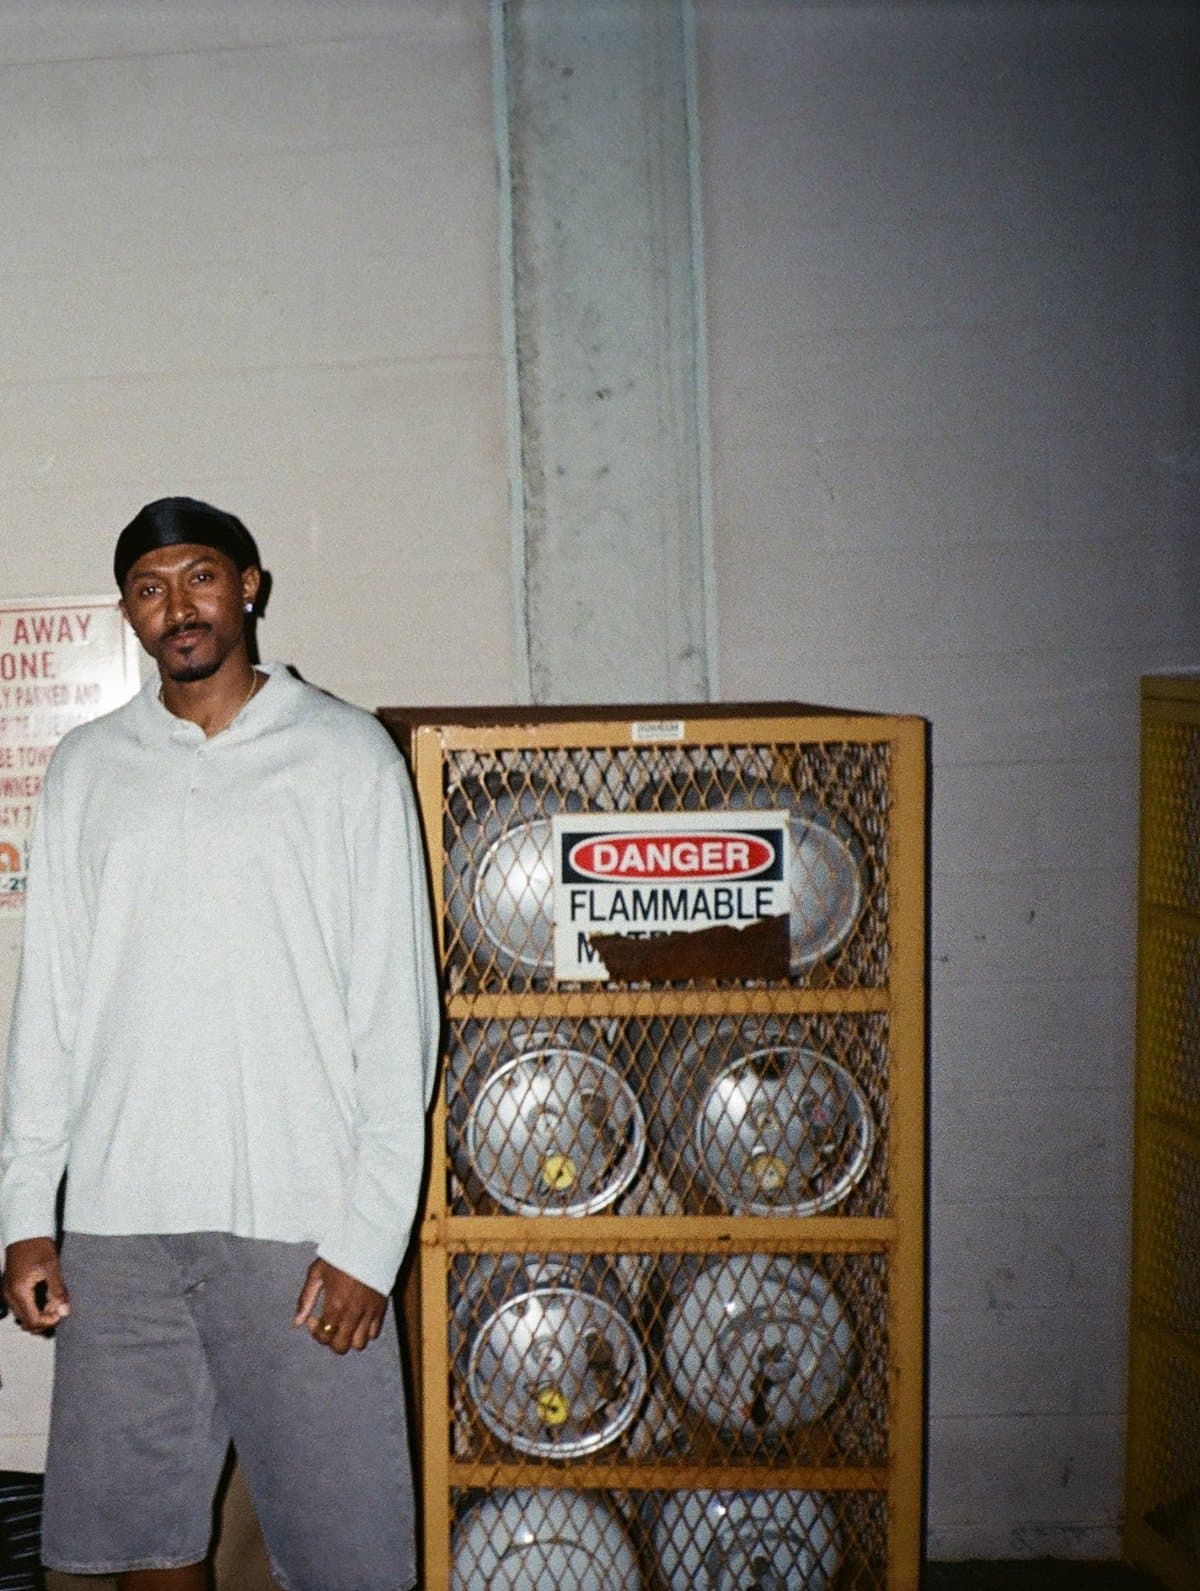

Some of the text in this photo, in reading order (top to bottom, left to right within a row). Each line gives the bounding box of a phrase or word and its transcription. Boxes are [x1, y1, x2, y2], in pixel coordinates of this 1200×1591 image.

[13, 615, 91, 645] AWAY
[592, 842, 750, 873] DANGER
[570, 886, 775, 921] FLAMMABLE
